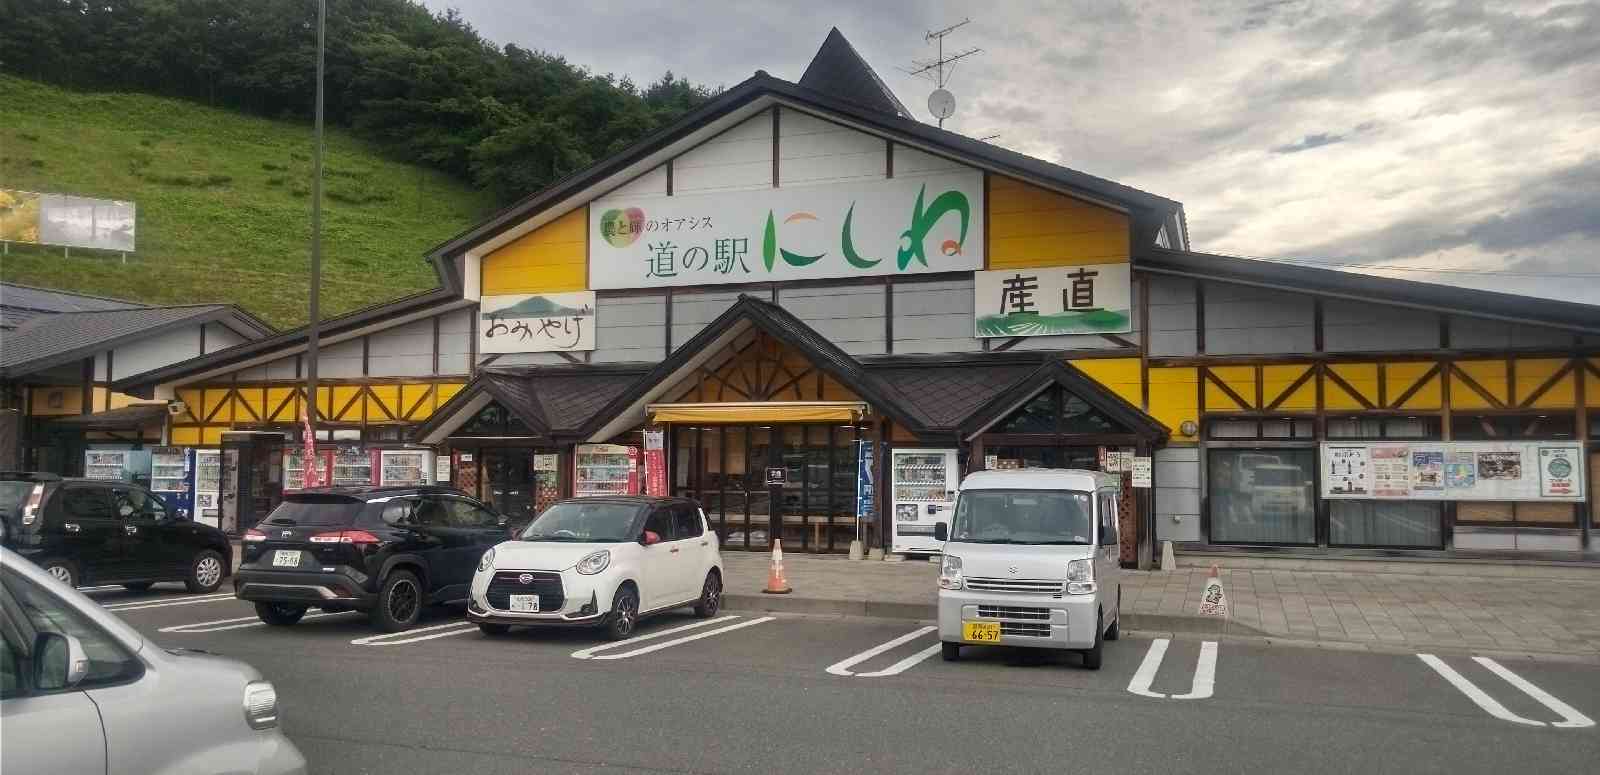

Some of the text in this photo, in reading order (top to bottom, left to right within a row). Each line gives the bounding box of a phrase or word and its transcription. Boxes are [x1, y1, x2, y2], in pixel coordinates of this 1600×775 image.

[645, 182, 971, 278] 道の駅 にしね
[1000, 267, 1104, 316] 産直
[485, 304, 590, 349] おみやげ
[972, 630, 999, 641] 66-57
